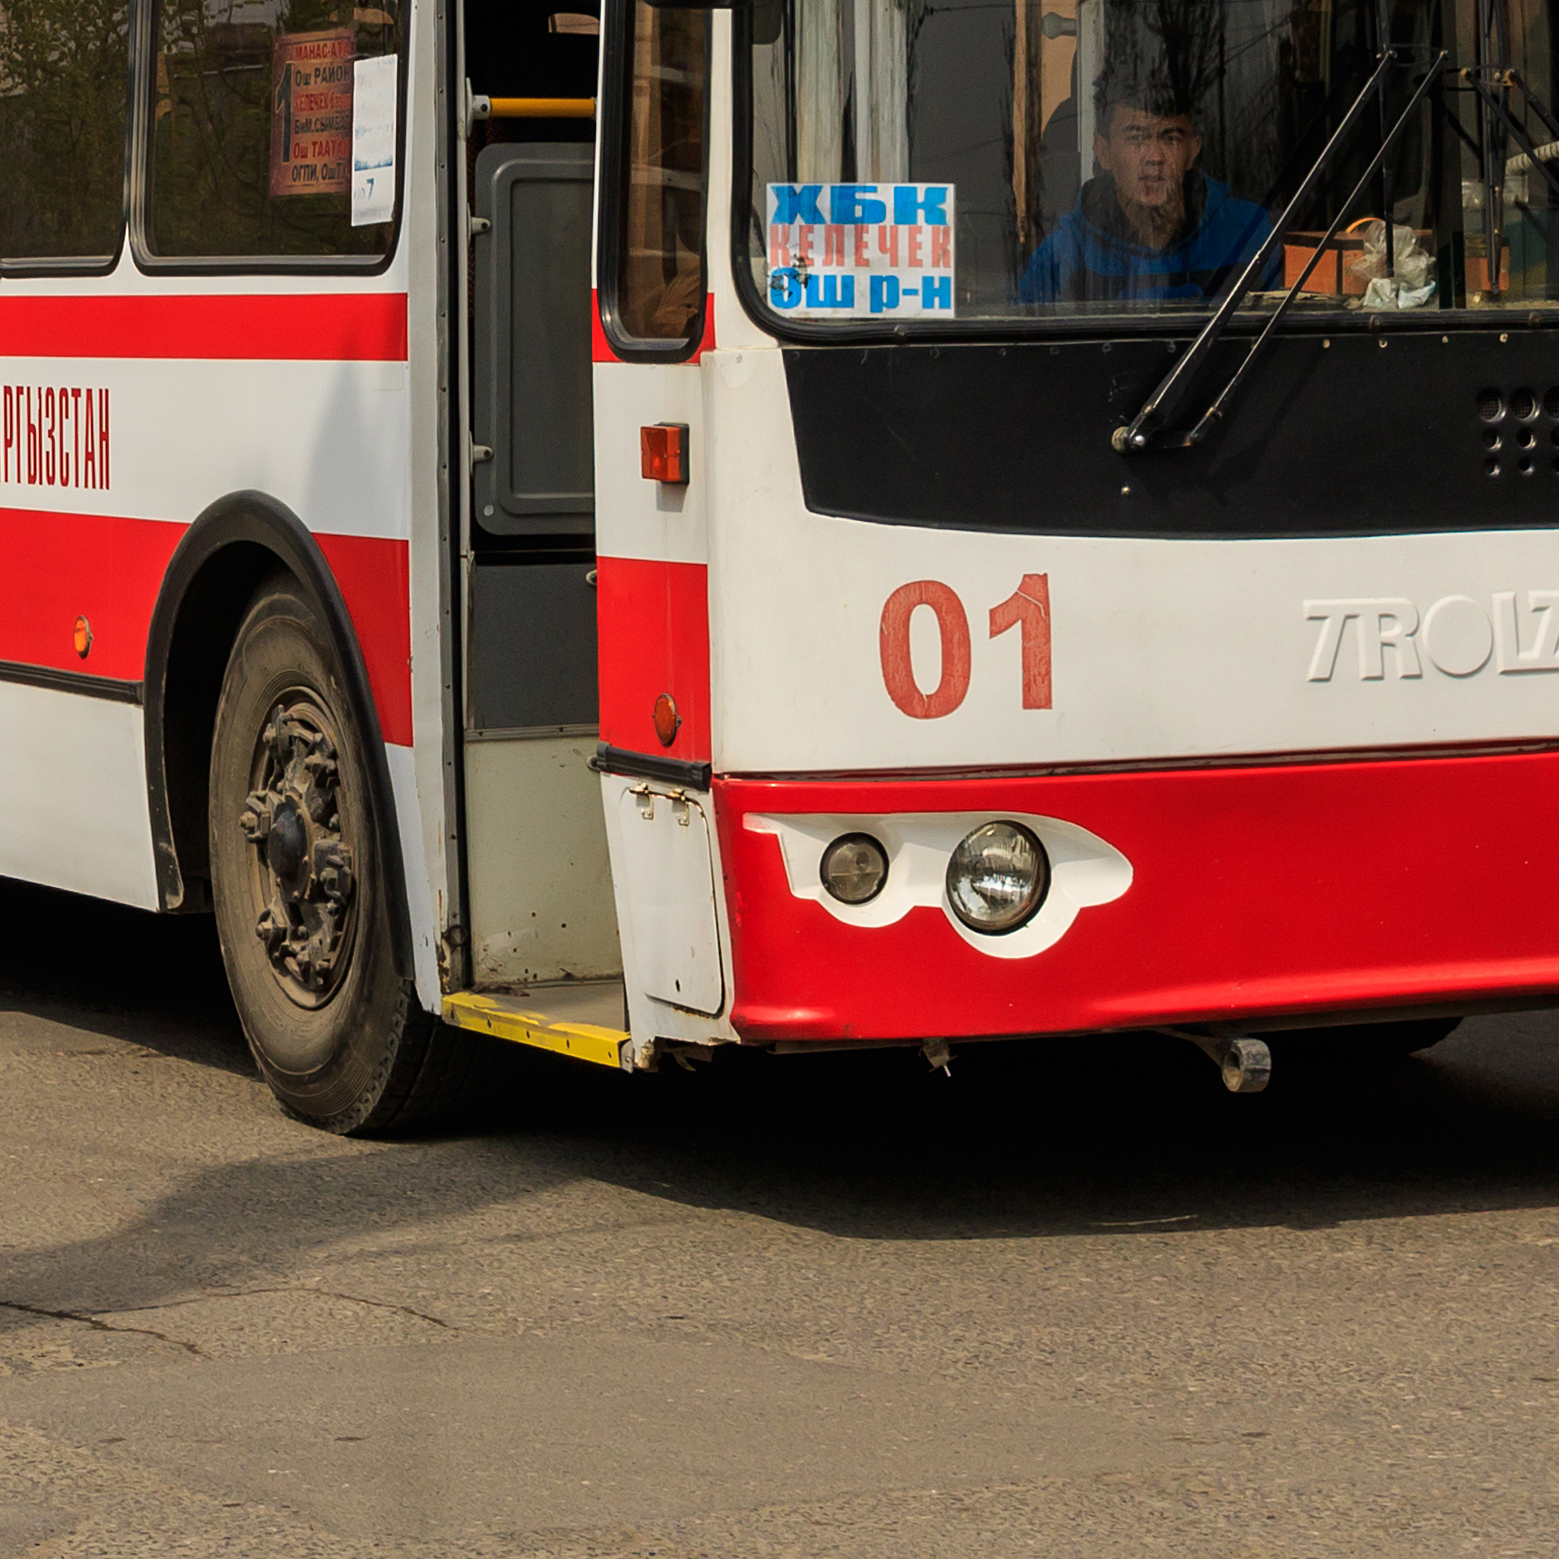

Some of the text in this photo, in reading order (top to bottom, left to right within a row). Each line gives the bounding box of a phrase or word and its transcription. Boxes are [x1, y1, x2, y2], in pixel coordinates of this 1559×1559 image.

[770, 185, 949, 225] ХБК
[770, 225, 951, 268] КЕЛЕЧЕК
[770, 267, 952, 313] Ош р-н
[878, 572, 1053, 720] 01
